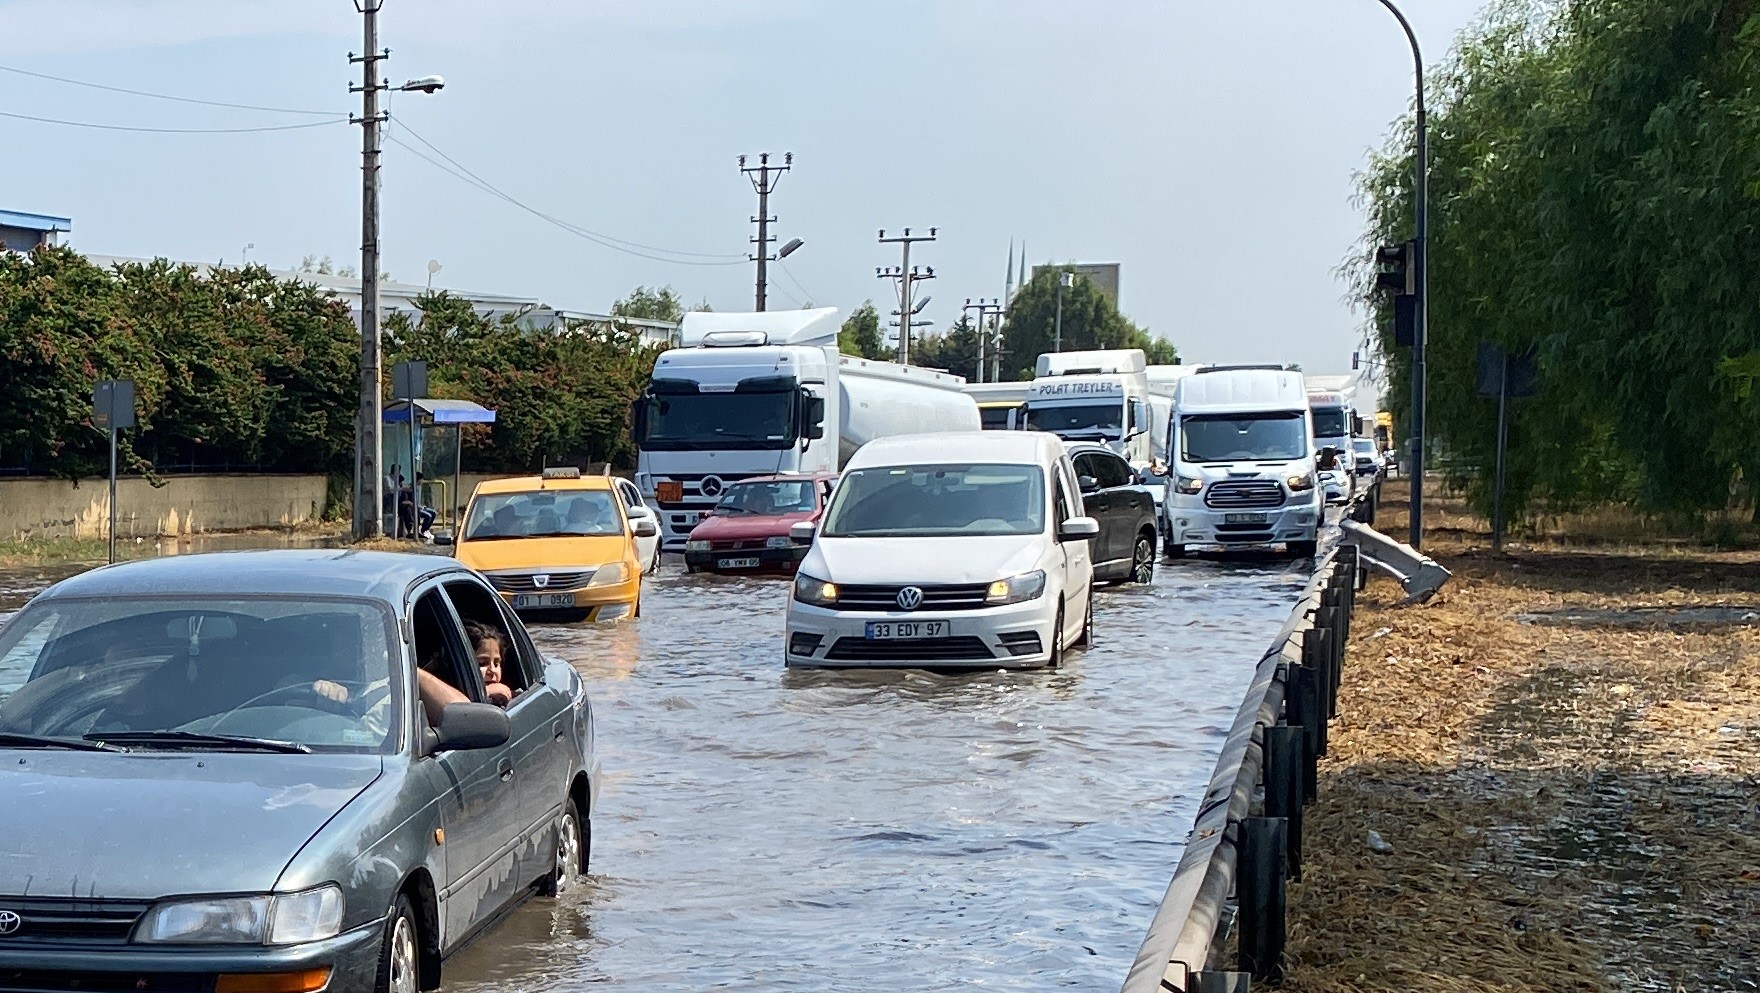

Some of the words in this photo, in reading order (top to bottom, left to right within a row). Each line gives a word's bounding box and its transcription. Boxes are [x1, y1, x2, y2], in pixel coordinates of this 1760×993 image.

[1040, 384, 1069, 395] POLAT
[1072, 382, 1113, 393] TREYLER
[519, 596, 529, 606] 01
[537, 595, 543, 605] T
[550, 594, 573, 604] 0920
[875, 625, 890, 637] 33
[897, 623, 920, 637] EDY
[927, 623, 942, 635] 97
